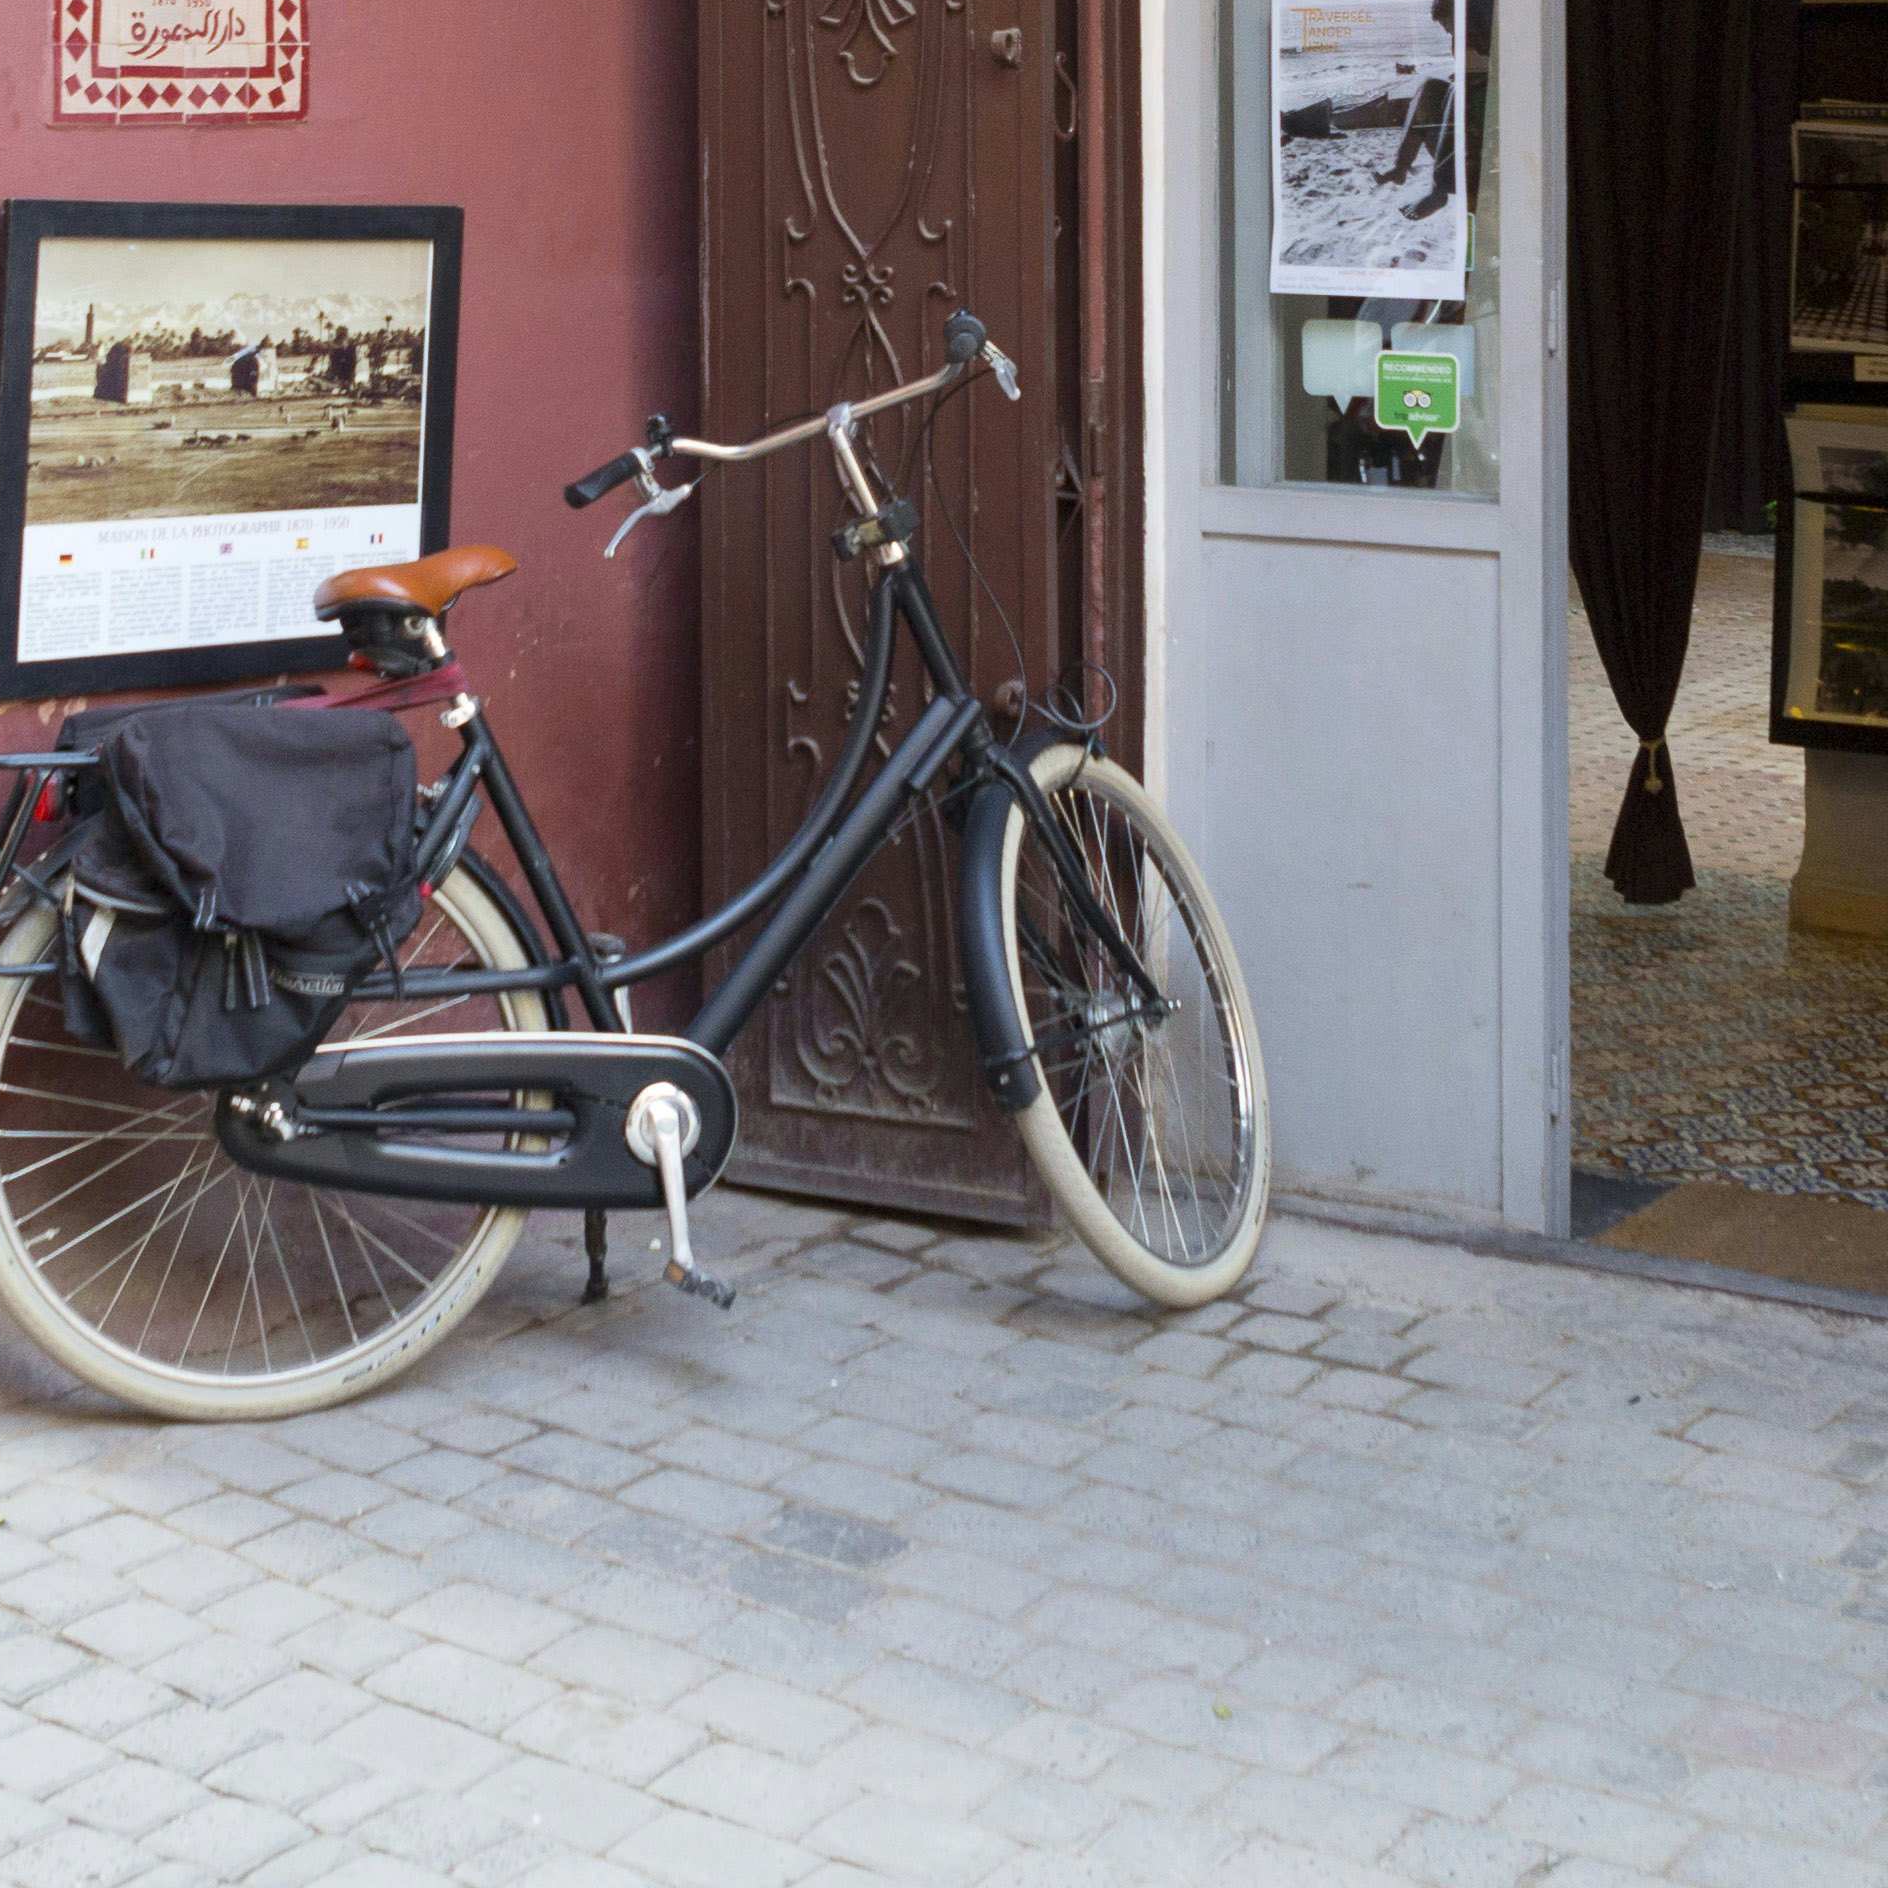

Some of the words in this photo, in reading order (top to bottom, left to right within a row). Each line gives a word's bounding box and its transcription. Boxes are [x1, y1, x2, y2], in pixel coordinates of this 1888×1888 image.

[98, 528, 148, 543] MAISON
[152, 526, 169, 540] DE
[172, 525, 188, 539] LA
[192, 520, 283, 538] PHOTOGRAPHIE
